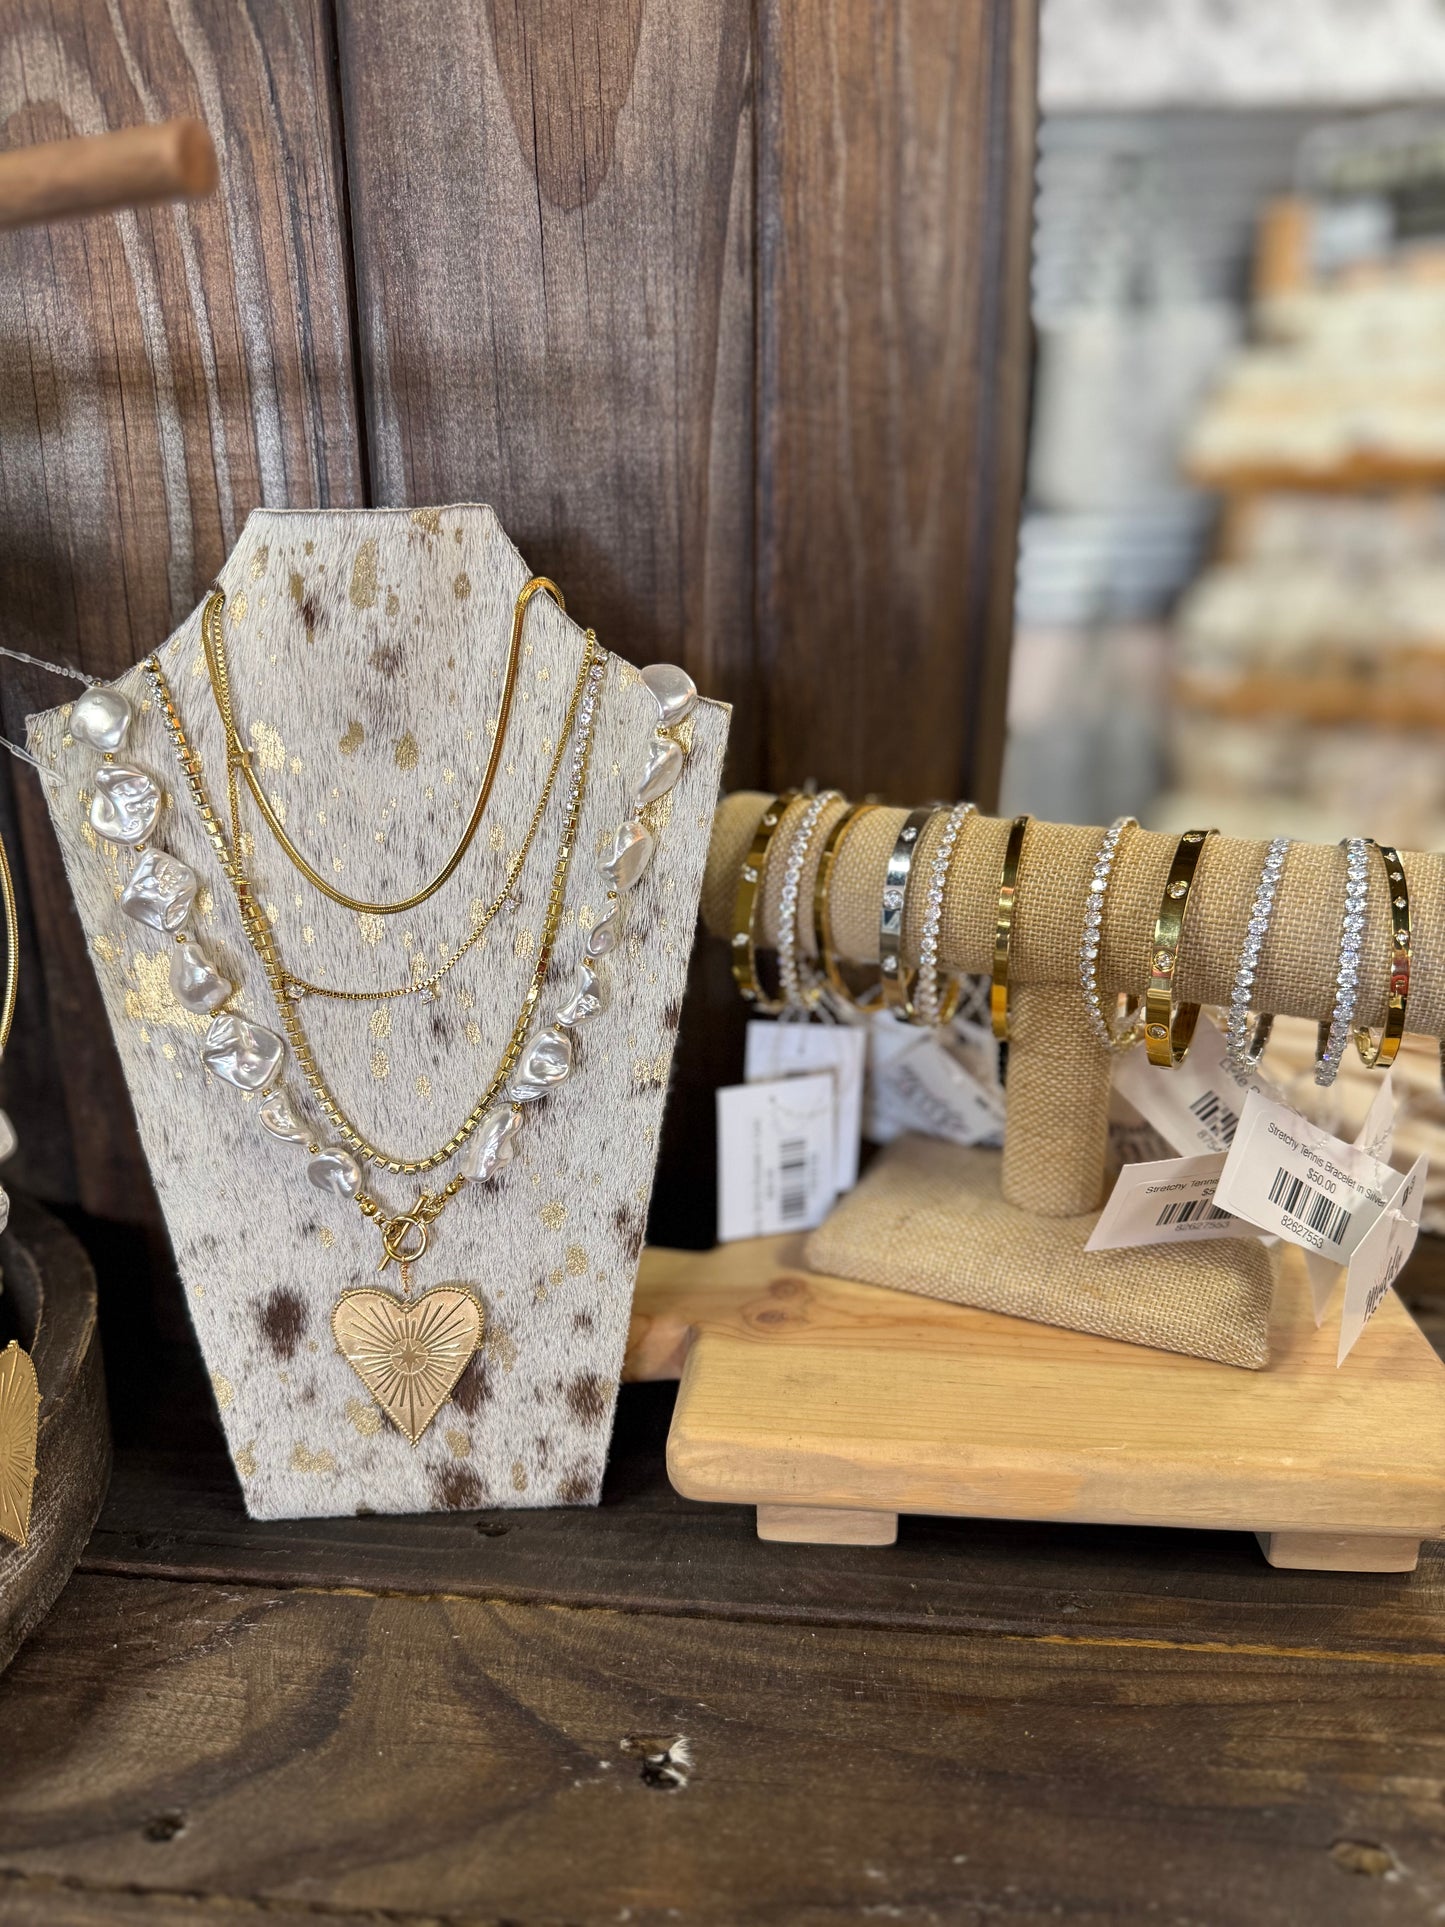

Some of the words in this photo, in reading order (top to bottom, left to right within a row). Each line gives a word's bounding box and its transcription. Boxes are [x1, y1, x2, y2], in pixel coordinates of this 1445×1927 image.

[1267, 1122, 1300, 1151] Stretchy
[1300, 1143, 1325, 1168] Tennis
[1324, 1161, 1357, 1190] Bracelet
[1356, 1183, 1365, 1194] in
[1364, 1188, 1386, 1208] Silver
[1145, 1182, 1188, 1194] Stretchy
[1201, 1187, 1216, 1197] $5
[1306, 1167, 1337, 1194] $50.00
[1280, 1214, 1324, 1249] 82627553
